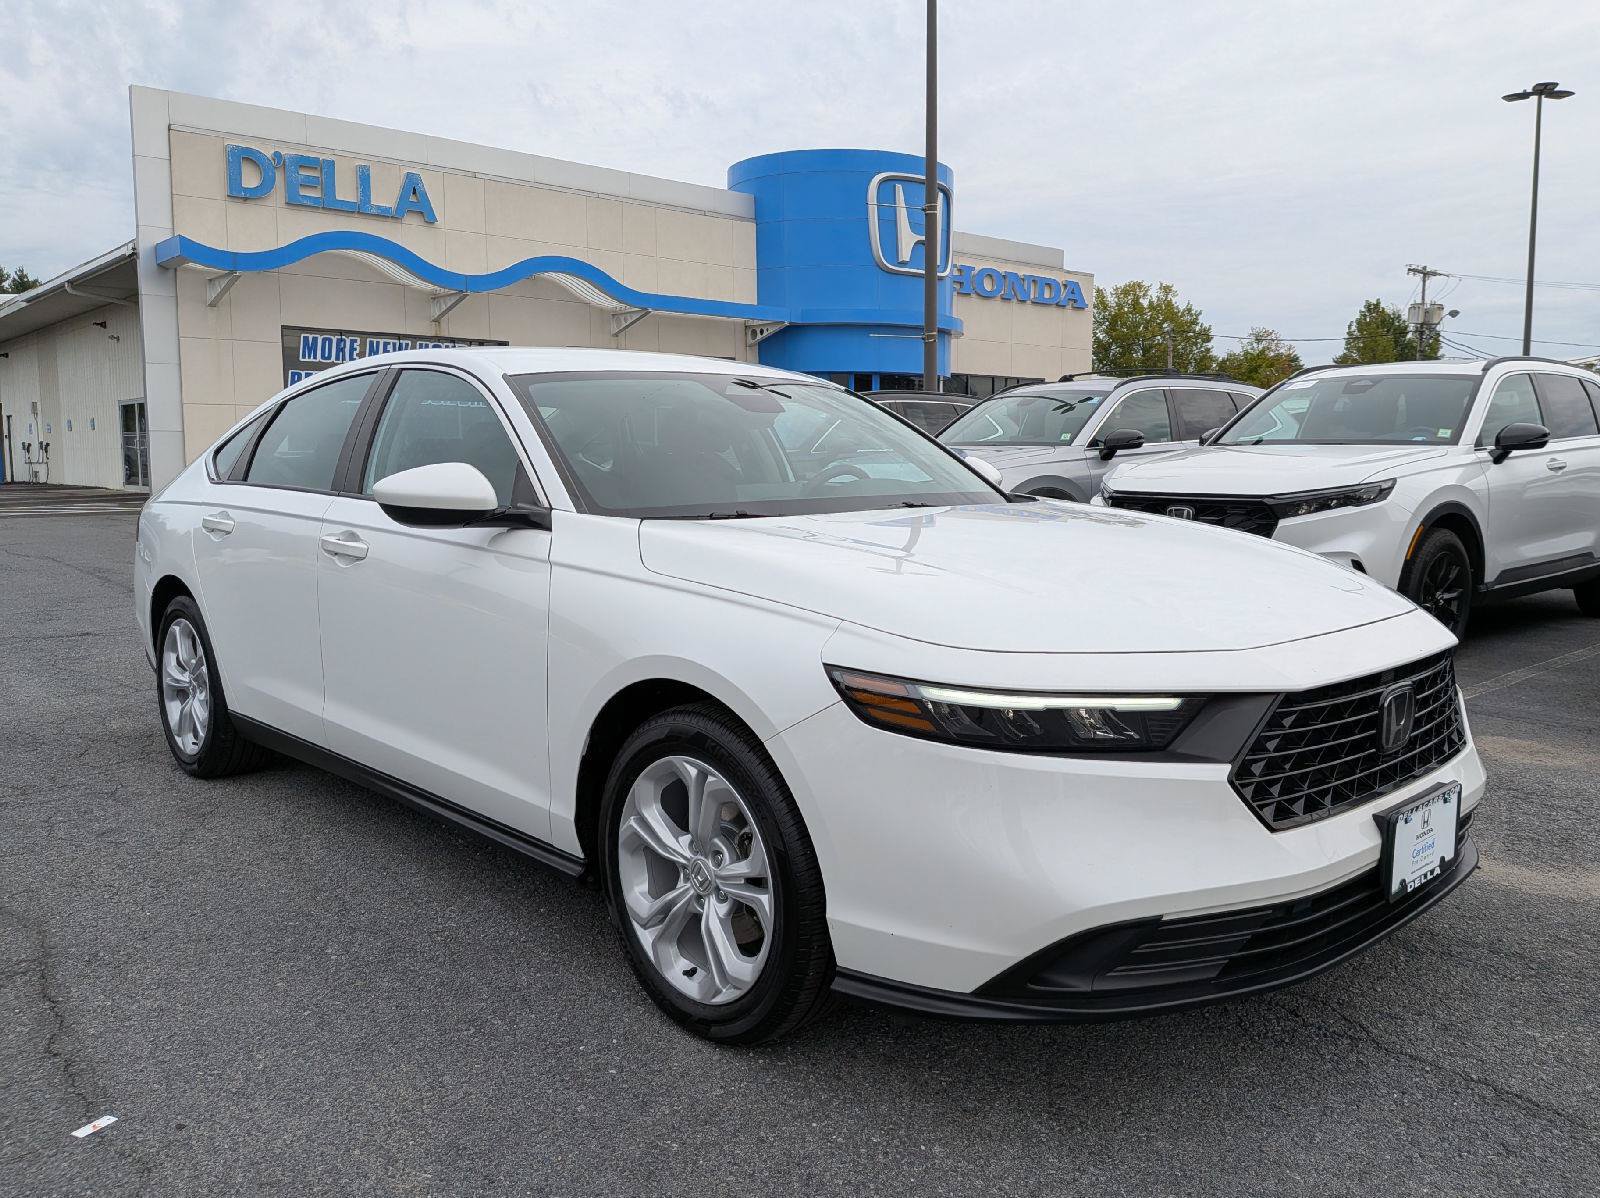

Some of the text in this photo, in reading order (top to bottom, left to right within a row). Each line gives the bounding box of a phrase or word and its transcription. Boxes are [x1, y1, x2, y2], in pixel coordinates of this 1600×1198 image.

[226, 143, 438, 225] D'ELLA
[953, 264, 1088, 309] HONDA
[300, 334, 360, 362] MORE
[1415, 827, 1434, 841] HONDA
[1411, 840, 1436, 859] Certified
[1407, 866, 1441, 893] DELLA
